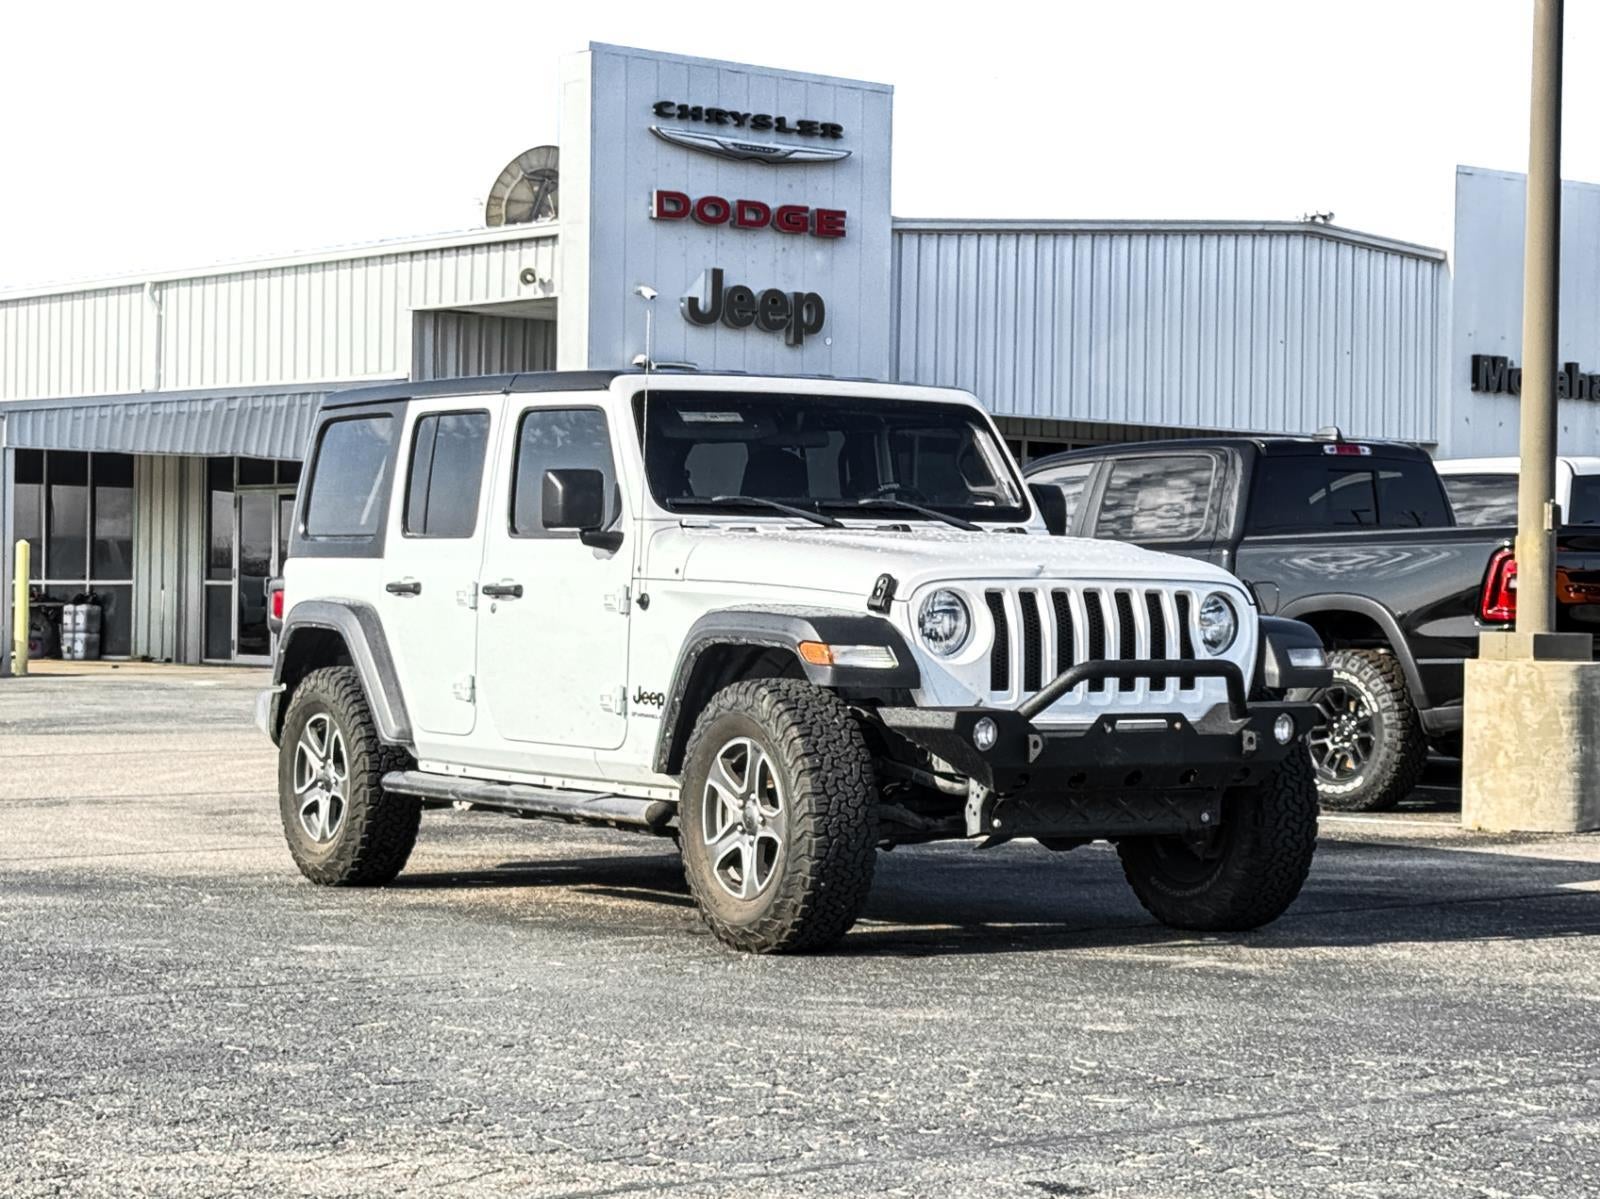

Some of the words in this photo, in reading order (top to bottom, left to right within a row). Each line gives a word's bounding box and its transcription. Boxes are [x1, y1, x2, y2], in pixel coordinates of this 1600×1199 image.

[652, 100, 844, 139] CHRYSLER
[652, 189, 847, 239] DODGE
[682, 267, 826, 346] Jeep
[632, 685, 666, 710] Jeep
